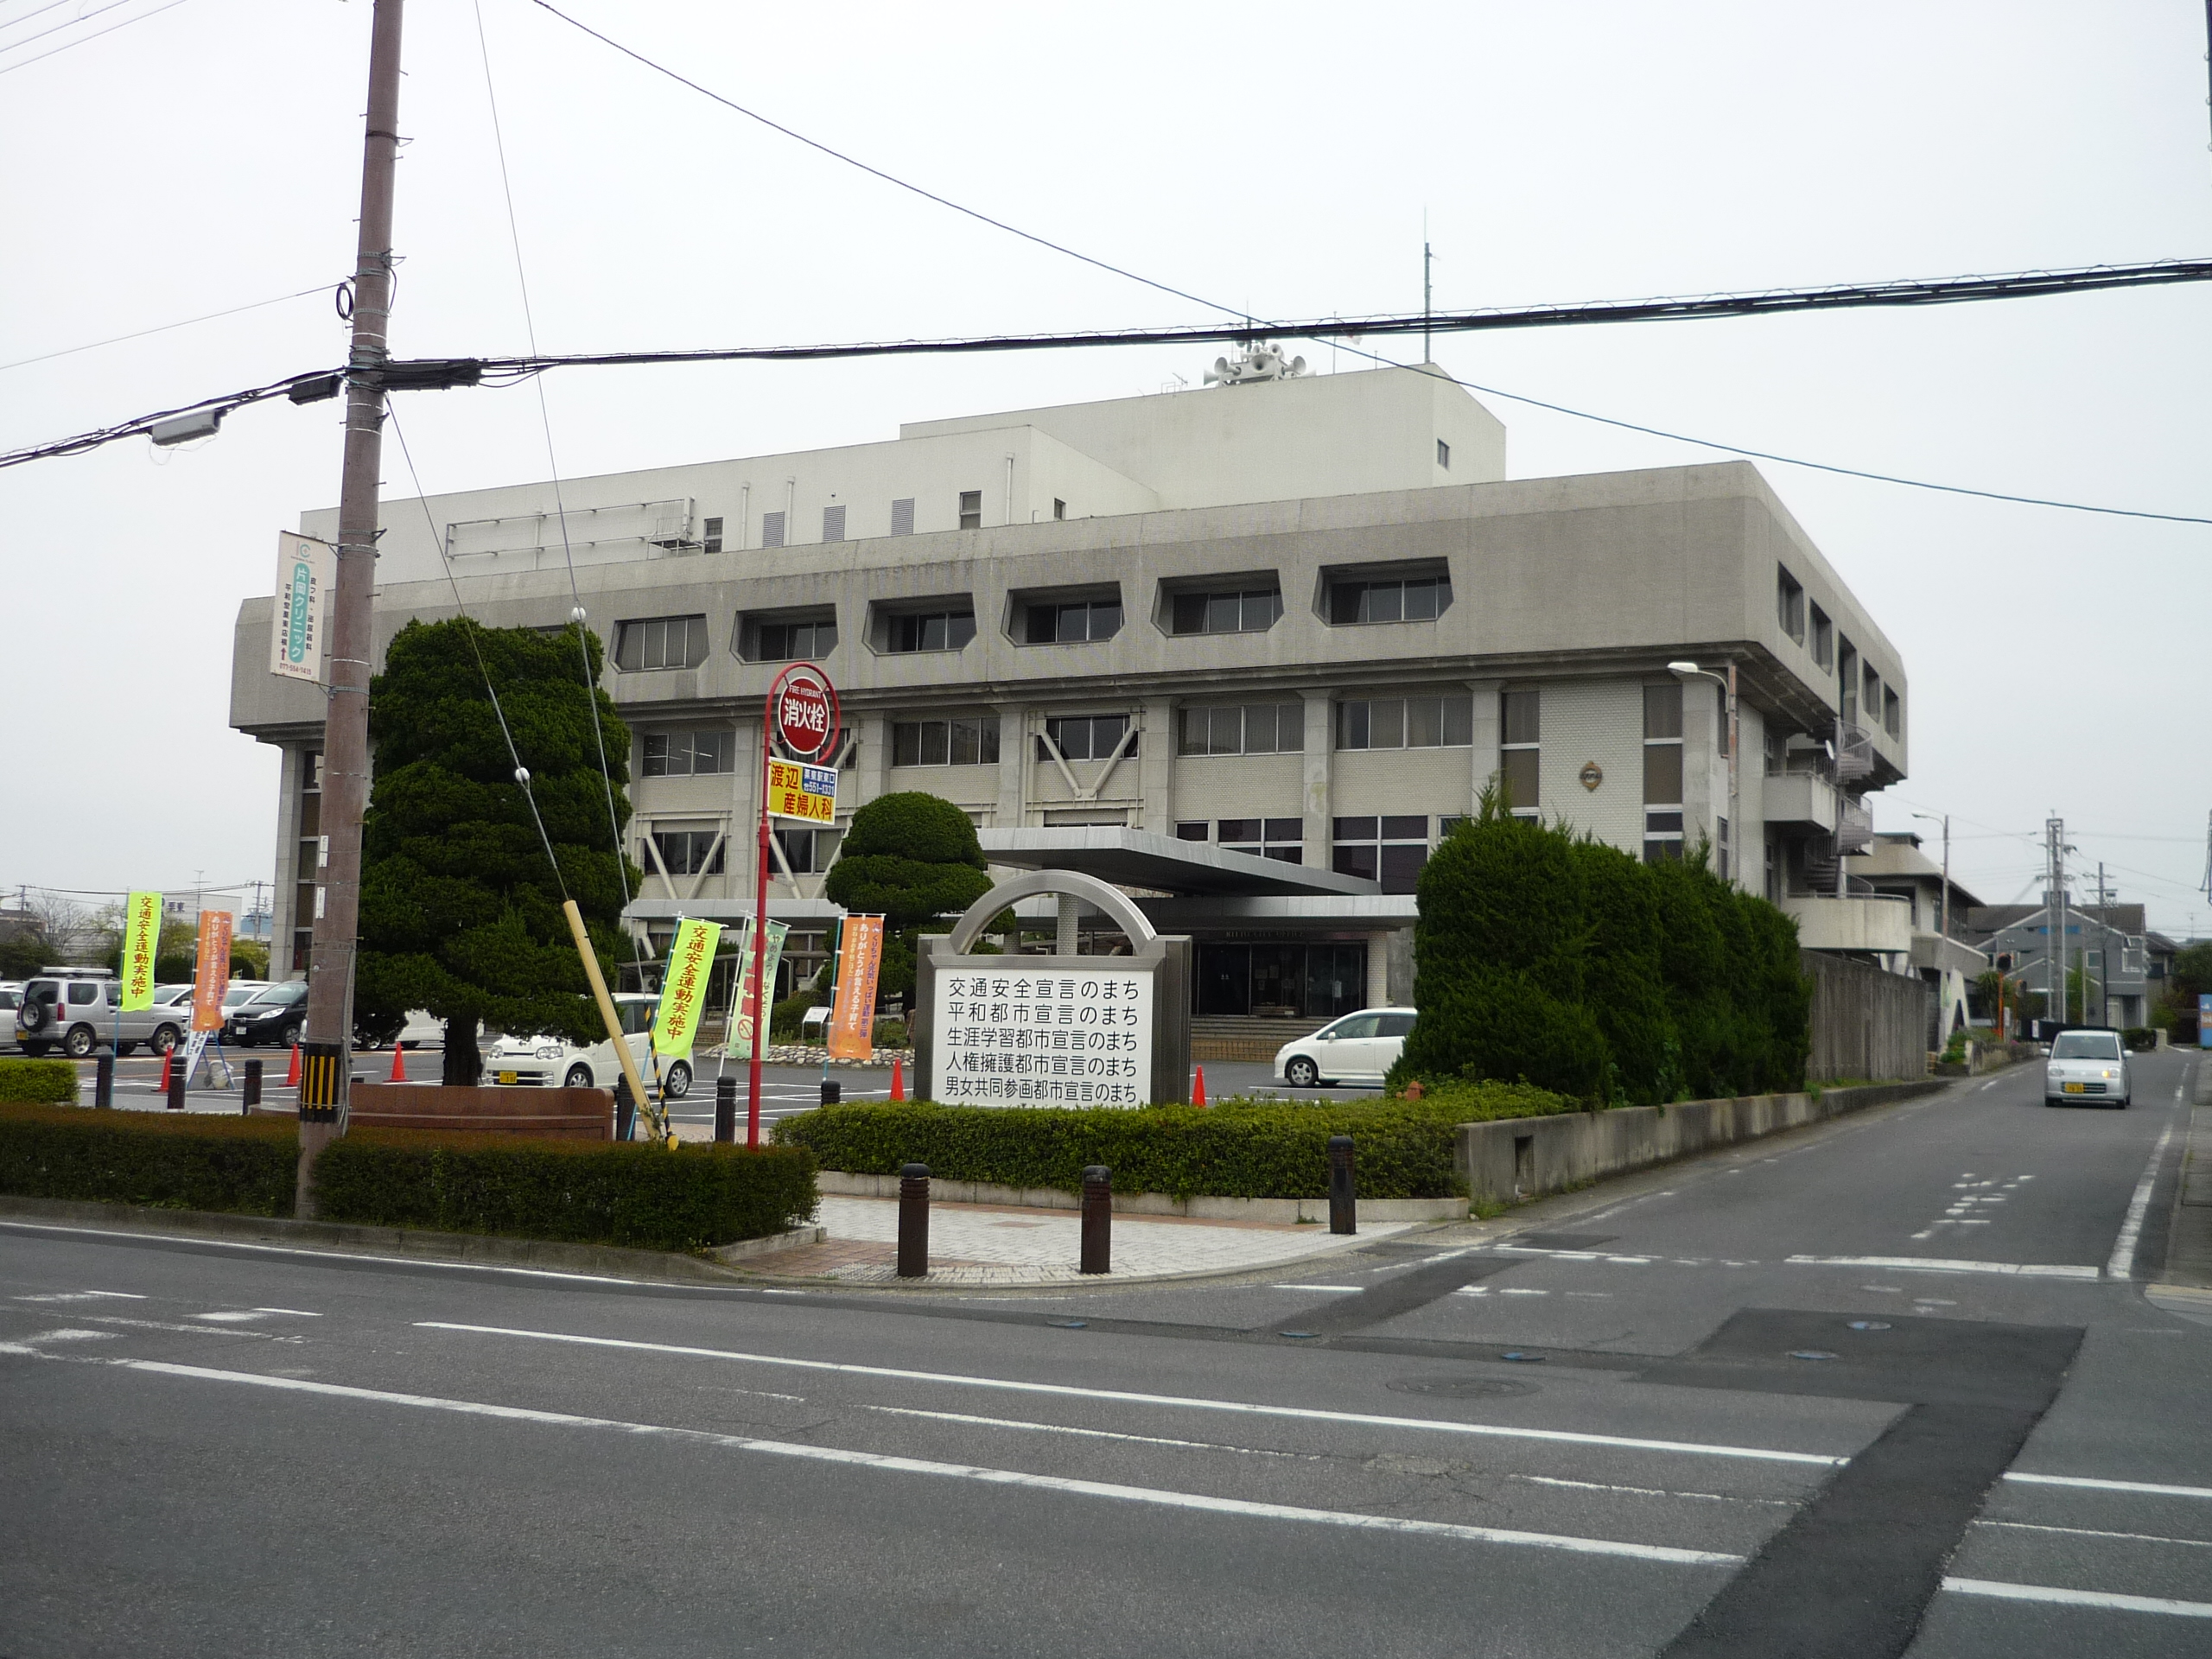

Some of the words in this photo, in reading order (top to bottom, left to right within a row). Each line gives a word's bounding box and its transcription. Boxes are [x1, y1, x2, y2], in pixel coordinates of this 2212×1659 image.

[291, 567, 308, 658] 片岡クリニック
[789, 685, 800, 695] FIRE
[800, 687, 822, 699] HYDRANT
[784, 697, 826, 733] 消火栓
[771, 764, 799, 790] 渡辺
[783, 791, 832, 820] 産婦人科
[130, 895, 154, 999] 交通安全運動実施中
[666, 925, 709, 1040] 交通安全運動実施中
[848, 923, 869, 1031] ありがとうが言える子育て
[949, 977, 1139, 1000] 交通安全宣言のまち
[948, 1001, 1138, 1026] 平和都市宣言のまち
[947, 1027, 1138, 1051] 生涯学習都市宣言のまち
[945, 1051, 1137, 1077] 人権擁護都市宣言のまち
[945, 1076, 1136, 1103] 男女共同参画都市宣言のまち
